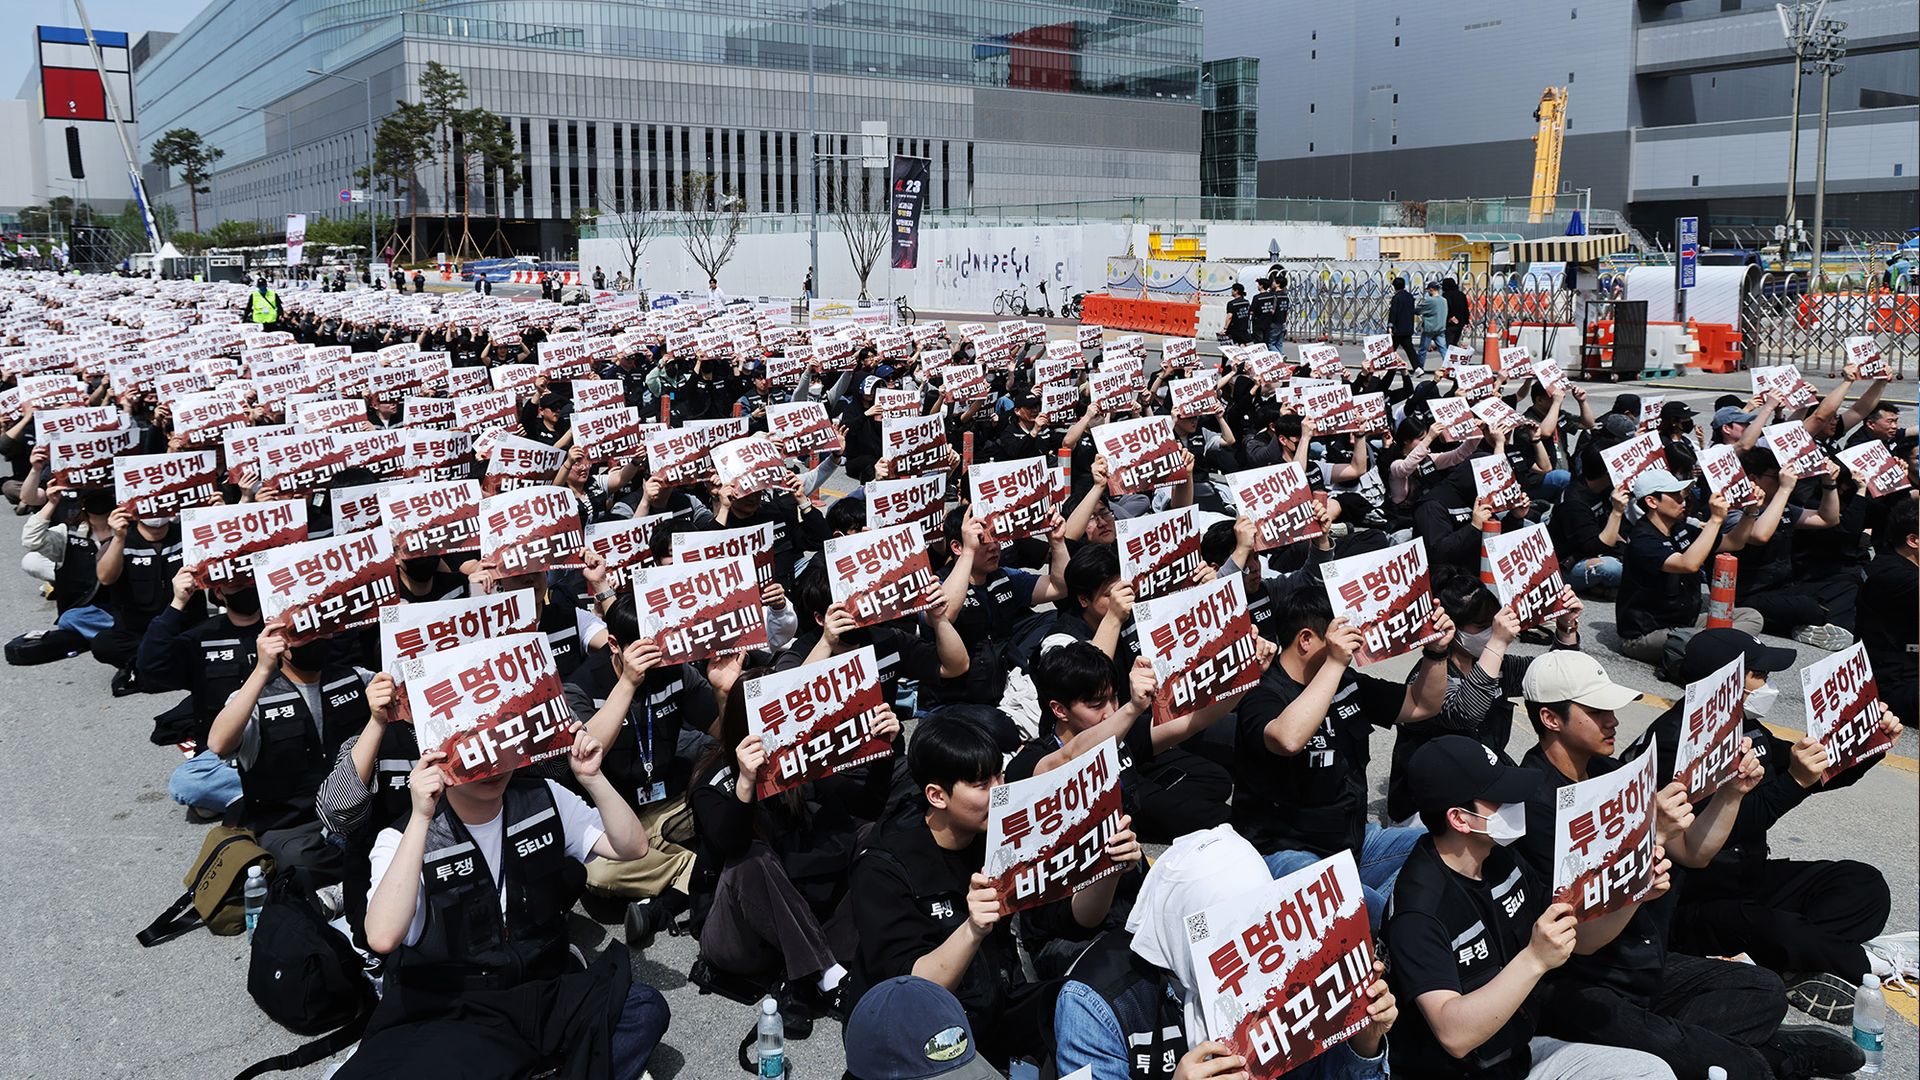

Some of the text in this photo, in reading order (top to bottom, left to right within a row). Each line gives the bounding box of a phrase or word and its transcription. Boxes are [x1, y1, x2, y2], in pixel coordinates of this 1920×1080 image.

[895, 179, 922, 193] 4.23
[543, 344, 586, 364] 투명하게
[818, 342, 850, 357] 투명하게
[823, 356, 852, 370] 바꾸고!!!
[262, 374, 311, 396] 투명하게
[373, 370, 417, 385] 투명하게
[453, 370, 487, 386] 투명하게
[551, 363, 591, 380] 바꾸고!!!
[947, 367, 979, 384] 투명하게
[1094, 373, 1127, 393] 투명하게
[379, 387, 421, 401] 바꾸고!!!
[578, 383, 620, 403] 투명하게
[953, 383, 986, 400] 바꾸고!!!
[1100, 394, 1132, 412] 바꾸고!!!
[1174, 380, 1209, 398] 투명하게
[1309, 387, 1348, 412] 투명하게
[179, 400, 237, 425] 투명하게
[304, 401, 359, 424] 투명하게
[460, 395, 508, 418] 투명하게
[774, 405, 823, 432] 투명하게
[1184, 397, 1217, 414] 바꾸고!!!
[1436, 401, 1464, 419] 투명하게
[470, 415, 516, 436] 바꾸고!!!
[578, 410, 632, 439] 투명하게
[889, 420, 942, 449] 투명하게
[1316, 410, 1357, 433] 바꾸고!!!
[1449, 420, 1478, 438] 바꾸고!!!
[58, 430, 131, 461] 투명하게
[267, 436, 335, 467] 투명하게
[413, 434, 469, 460] 투명하게
[588, 431, 638, 460] 바꾸고!!!
[654, 427, 707, 460] 투명하게
[785, 428, 837, 453] 바꾸고!!!
[1104, 417, 1171, 457] 투명하게
[500, 448, 561, 470] 투명하게
[666, 457, 712, 482] 바꾸고!!!
[897, 446, 949, 474] 바꾸고!!!
[1120, 450, 1185, 488] 바꾸고!!!
[1612, 437, 1654, 473] 투명하게
[1852, 442, 1887, 472] 투명하게
[123, 453, 206, 491] 투명하게
[281, 462, 345, 492] 바꾸고!!!
[978, 464, 1045, 503] 투명하게
[136, 482, 213, 516] 바꾸고!!!
[389, 482, 470, 522] 투명하게
[873, 479, 941, 518] 투명하게
[1239, 465, 1298, 510] 투명하게
[192, 504, 294, 551] 투명하게
[487, 491, 570, 536] 투명하게
[992, 496, 1052, 535] 바꾸고!!!
[1260, 501, 1316, 542] 바꾸고!!!
[406, 517, 480, 552] 바꾸고!!!
[502, 529, 583, 570] 바꾸고!!!
[1126, 511, 1193, 563] 투명하게
[267, 533, 378, 597] 투명하게
[835, 526, 916, 583] 투명하게
[1497, 527, 1548, 585] 투명하게
[645, 560, 744, 618] 투명하게
[1139, 549, 1200, 599] 바꾸고!!!
[1338, 543, 1421, 613] 투명하게
[292, 575, 396, 634] 바꾸고!!!
[856, 568, 933, 619] 바꾸고!!!
[1517, 569, 1564, 623] 바꾸고!!!
[394, 595, 519, 659] 투명하게
[665, 604, 762, 657] 바꾸고!!!
[1150, 580, 1239, 661] 투명하게
[1254, 608, 1273, 624] SELU
[1364, 590, 1435, 654] 바꾸고!!!
[206, 649, 234, 662] 투쟁
[552, 644, 572, 659] ELU
[423, 637, 547, 722] 투명하게
[1171, 633, 1257, 708] 바꾸고!!!
[1810, 647, 1867, 723] 투명하게
[330, 690, 359, 708] SELU
[759, 655, 866, 735] 투명하게
[1688, 665, 1742, 746] 투명하게
[265, 704, 295, 721] 투쟁
[456, 695, 572, 770] 바꾸고!!!
[1826, 698, 1883, 768] 바꾸고!!!
[390, 777, 413, 791] 투
[1001, 748, 1108, 849] 투명하게
[515, 832, 554, 858] SELU
[436, 857, 474, 882] 투쟁
[931, 900, 954, 920] 투쟁
[1502, 888, 1526, 919] SELU
[1208, 864, 1344, 998] 투명하게
[1458, 938, 1490, 967] 투쟁
[1249, 940, 1374, 1066] 바꾸고!!!
[1136, 1048, 1177, 1074] 투쟁
